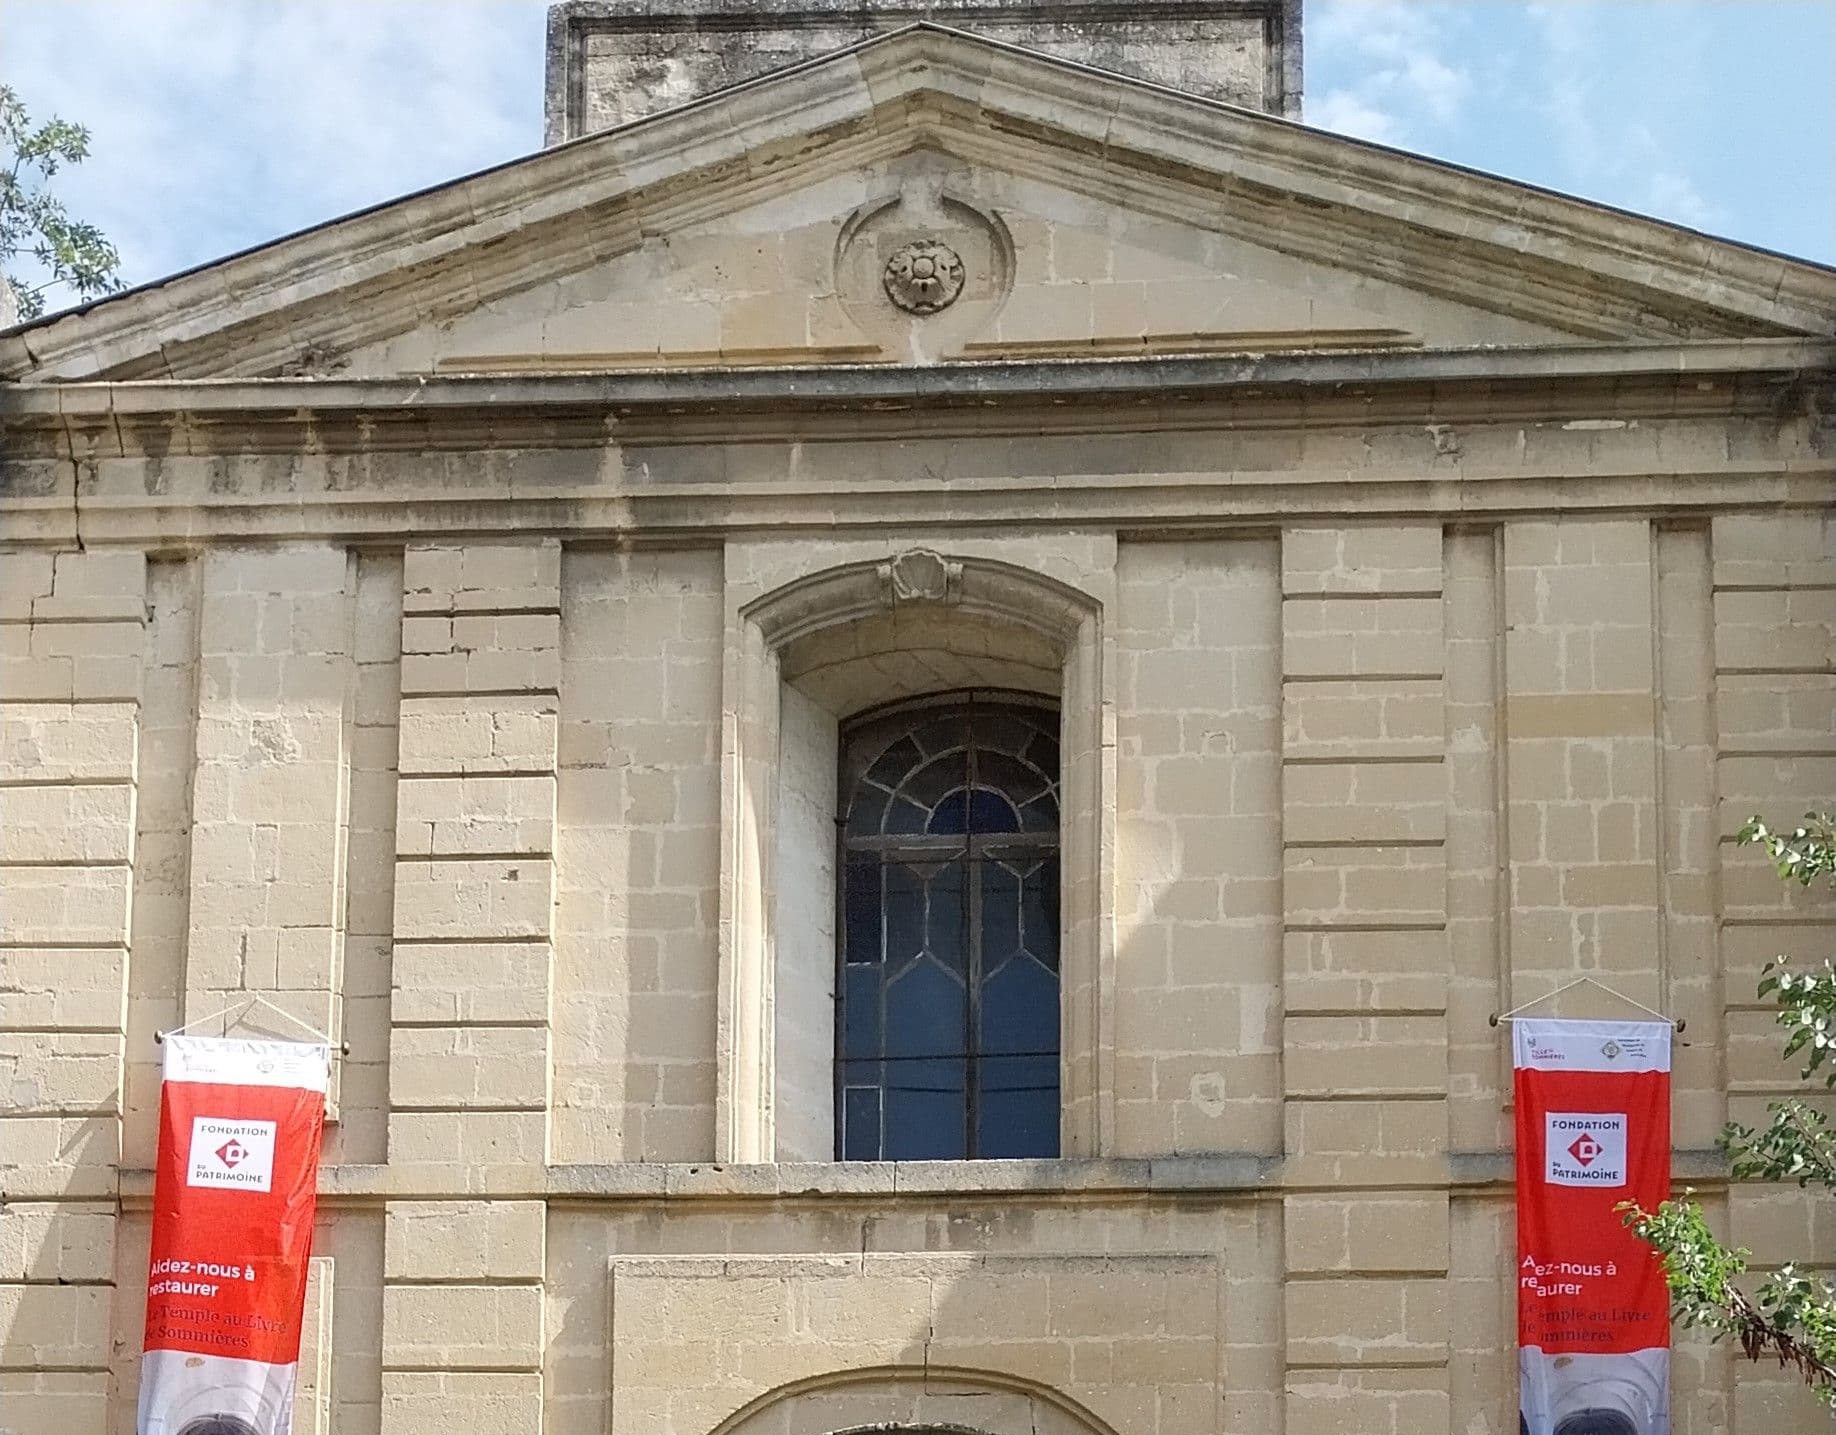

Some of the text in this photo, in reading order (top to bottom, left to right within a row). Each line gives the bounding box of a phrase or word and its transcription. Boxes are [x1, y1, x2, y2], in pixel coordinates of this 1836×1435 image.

[201, 1125, 268, 1136] FONDATION
[1552, 1120, 1620, 1130] FONDATION
[151, 1258, 255, 1281] Aidez-nous à
[1521, 1254, 1617, 1276] Aez-nous à
[149, 1279, 219, 1297] restaurer
[1521, 1276, 1583, 1297] reaurer
[160, 1305, 220, 1325] Temple
[224, 1314, 241, 1326] au
[246, 1315, 286, 1334] Livre
[1538, 1309, 1583, 1325] emple
[1588, 1312, 1607, 1321] au
[158, 1325, 248, 1347] Sommières
[1541, 1329, 1615, 1343] mmières
